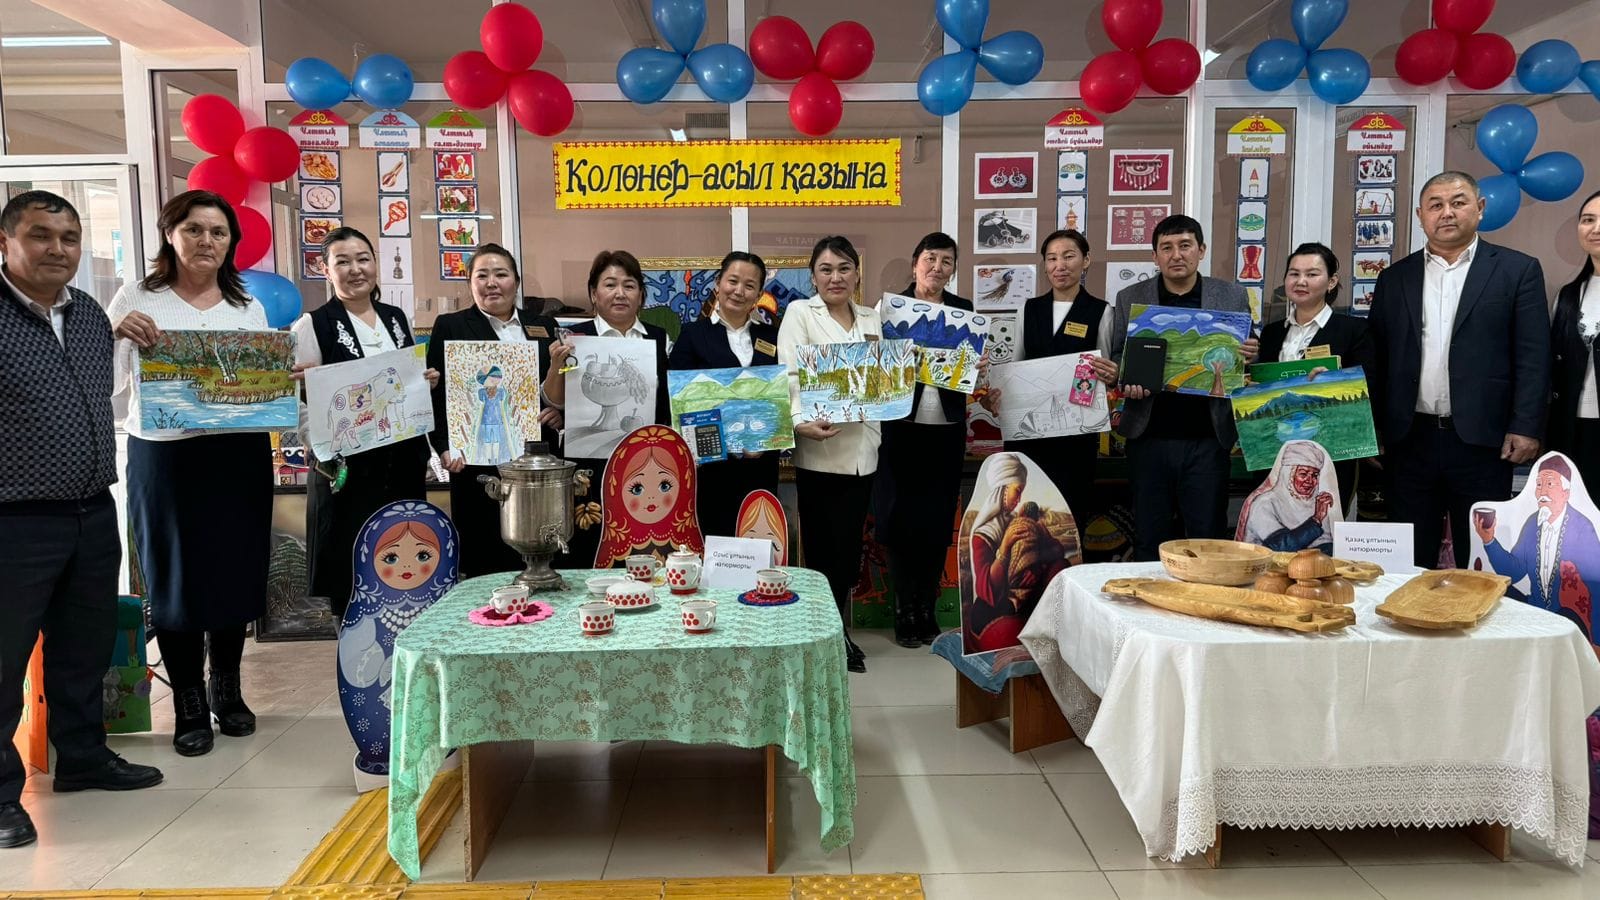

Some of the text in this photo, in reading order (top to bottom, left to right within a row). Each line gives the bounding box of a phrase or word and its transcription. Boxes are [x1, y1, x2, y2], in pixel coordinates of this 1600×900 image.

[781, 159, 888, 194] қазына
[1345, 536, 1365, 544] Қазақ
[1349, 546, 1393, 554] натюрморты
[714, 562, 752, 570] натюрморты
